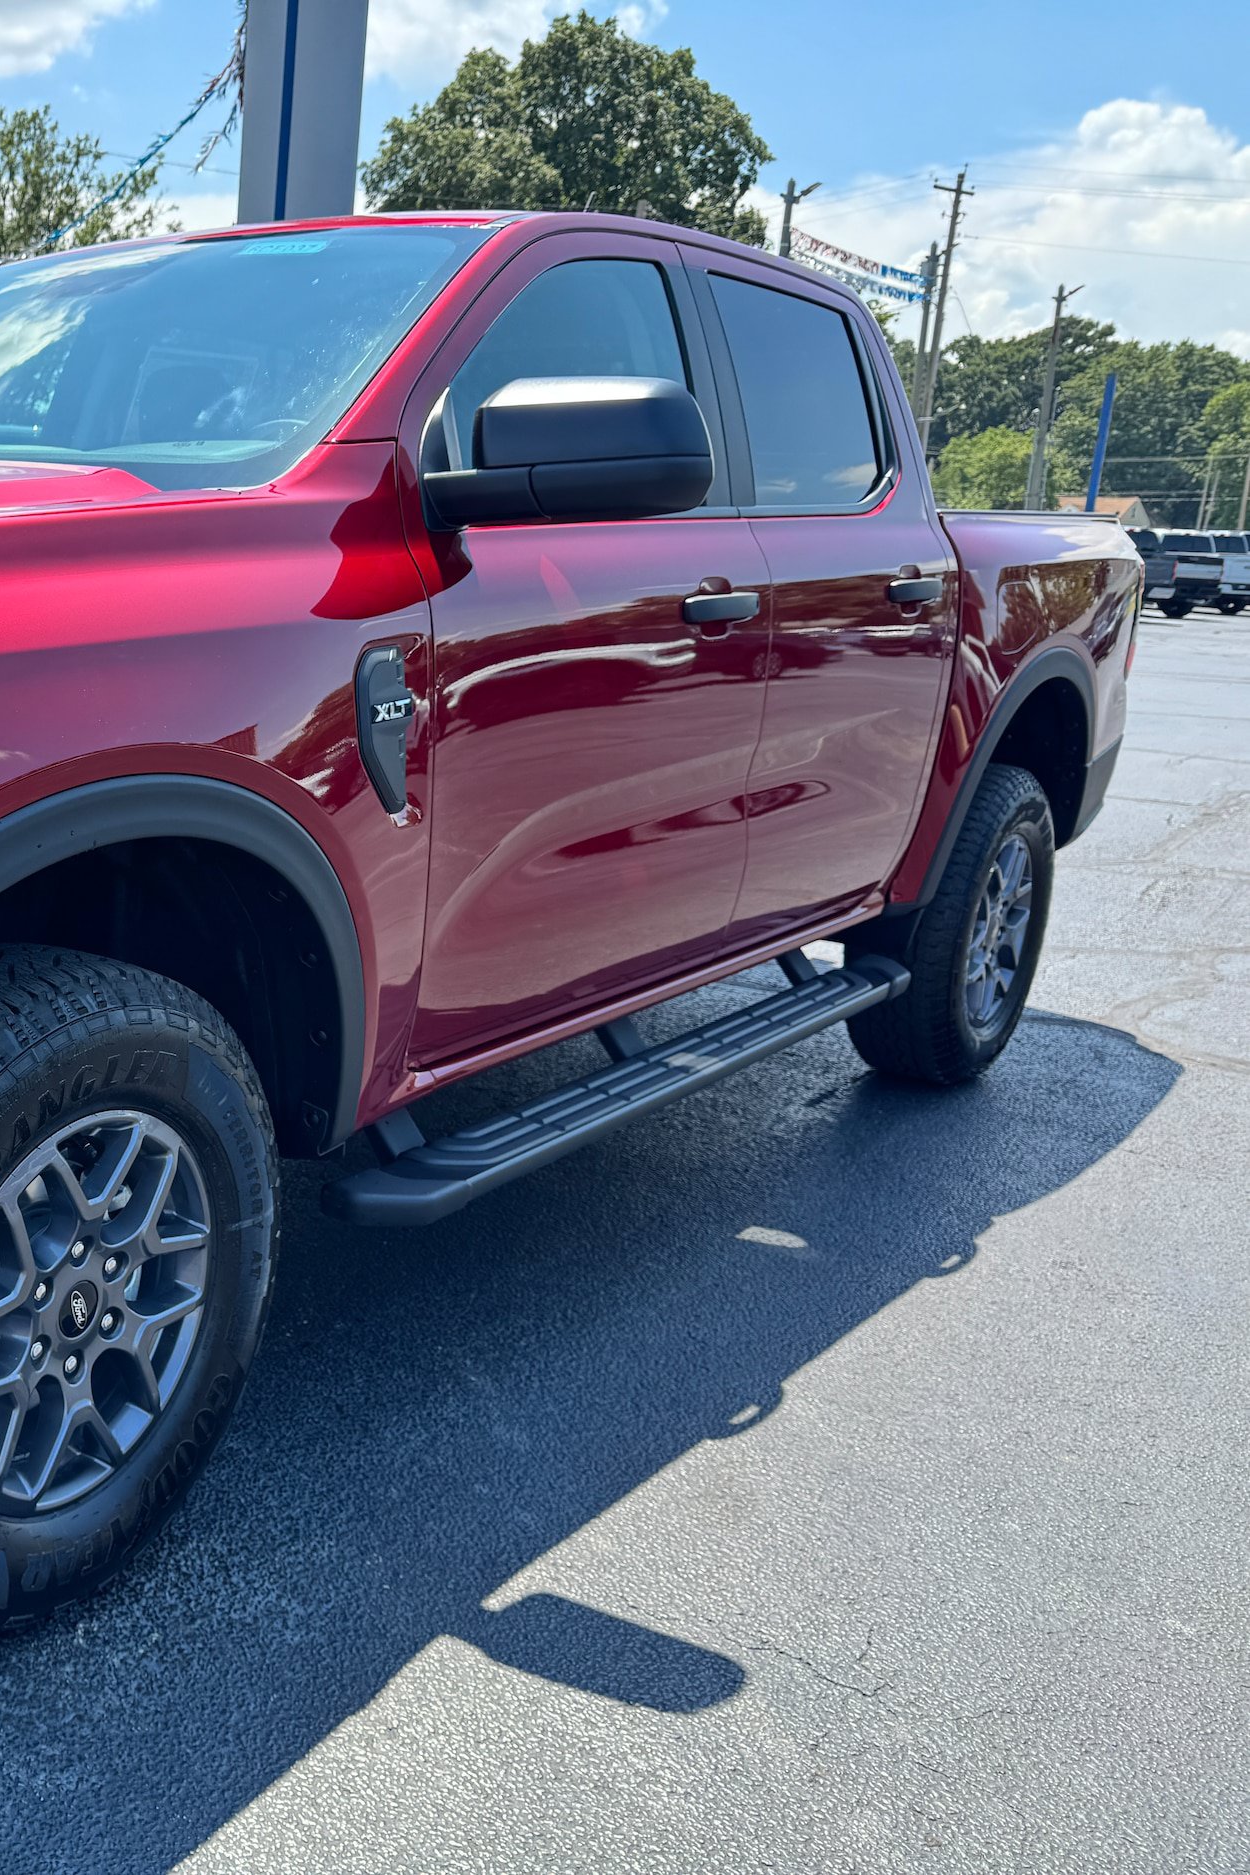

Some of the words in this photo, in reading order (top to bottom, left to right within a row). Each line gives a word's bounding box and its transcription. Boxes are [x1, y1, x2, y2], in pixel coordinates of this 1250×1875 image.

[374, 698, 411, 722] XLT
[222, 1108, 264, 1230] TERRITORY
[72, 1298, 86, 1324] Ford
